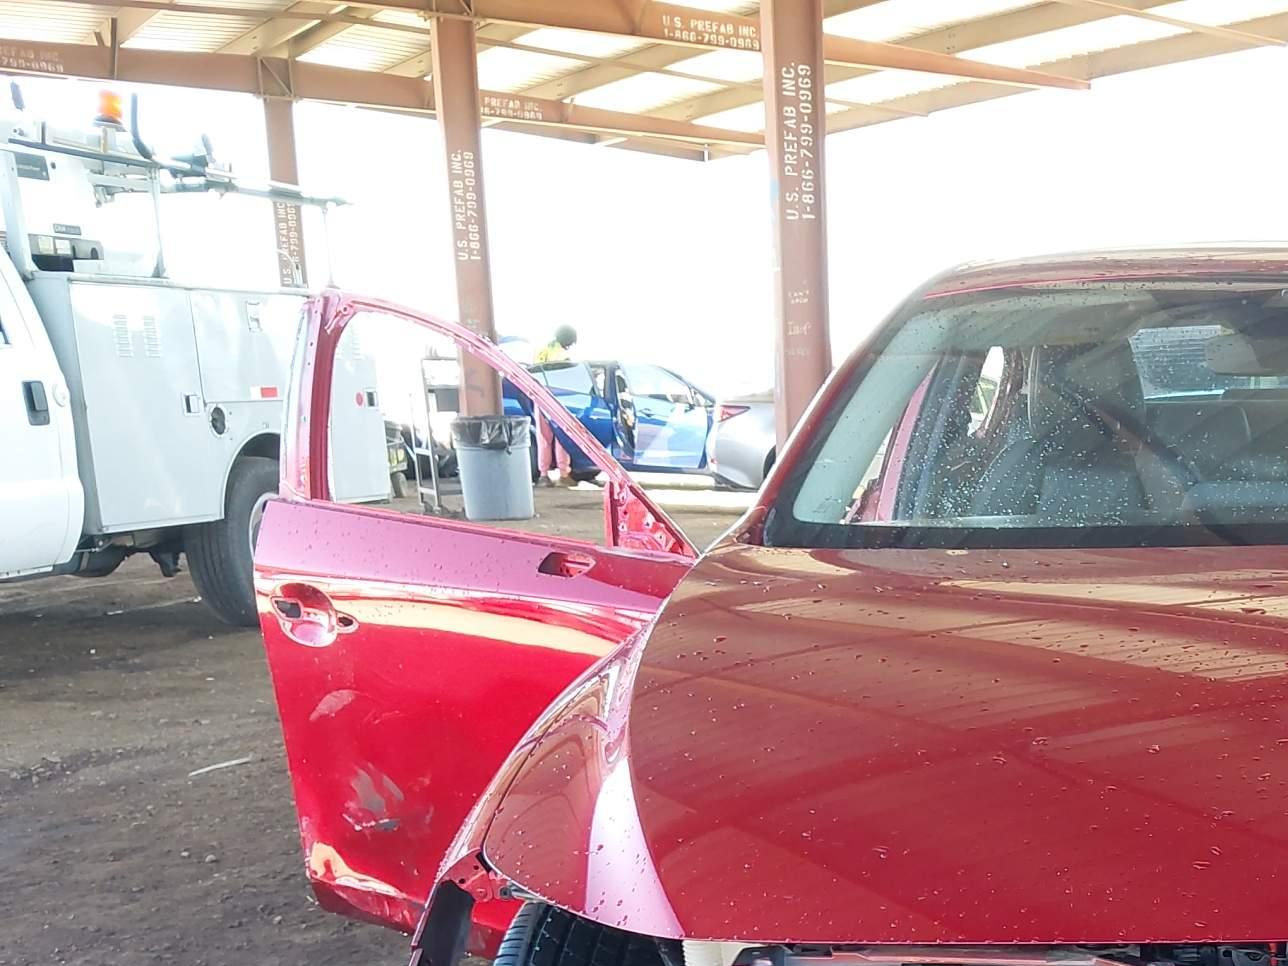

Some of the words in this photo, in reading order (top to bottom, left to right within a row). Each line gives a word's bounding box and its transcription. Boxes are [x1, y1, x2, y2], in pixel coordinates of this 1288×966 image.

[663, 27, 760, 51] 1-866-799-0969
[690, 18, 734, 35] PREFAB
[781, 62, 796, 96] INC.
[783, 106, 798, 176] PREFAB
[798, 64, 816, 220] 1-866-799-0969
[451, 149, 463, 174] INC.
[453, 180, 466, 230] PREFAB
[463, 151, 482, 260] 1-866-799-0969
[786, 187, 799, 220] U.S.
[457, 237, 469, 260] U.S.
